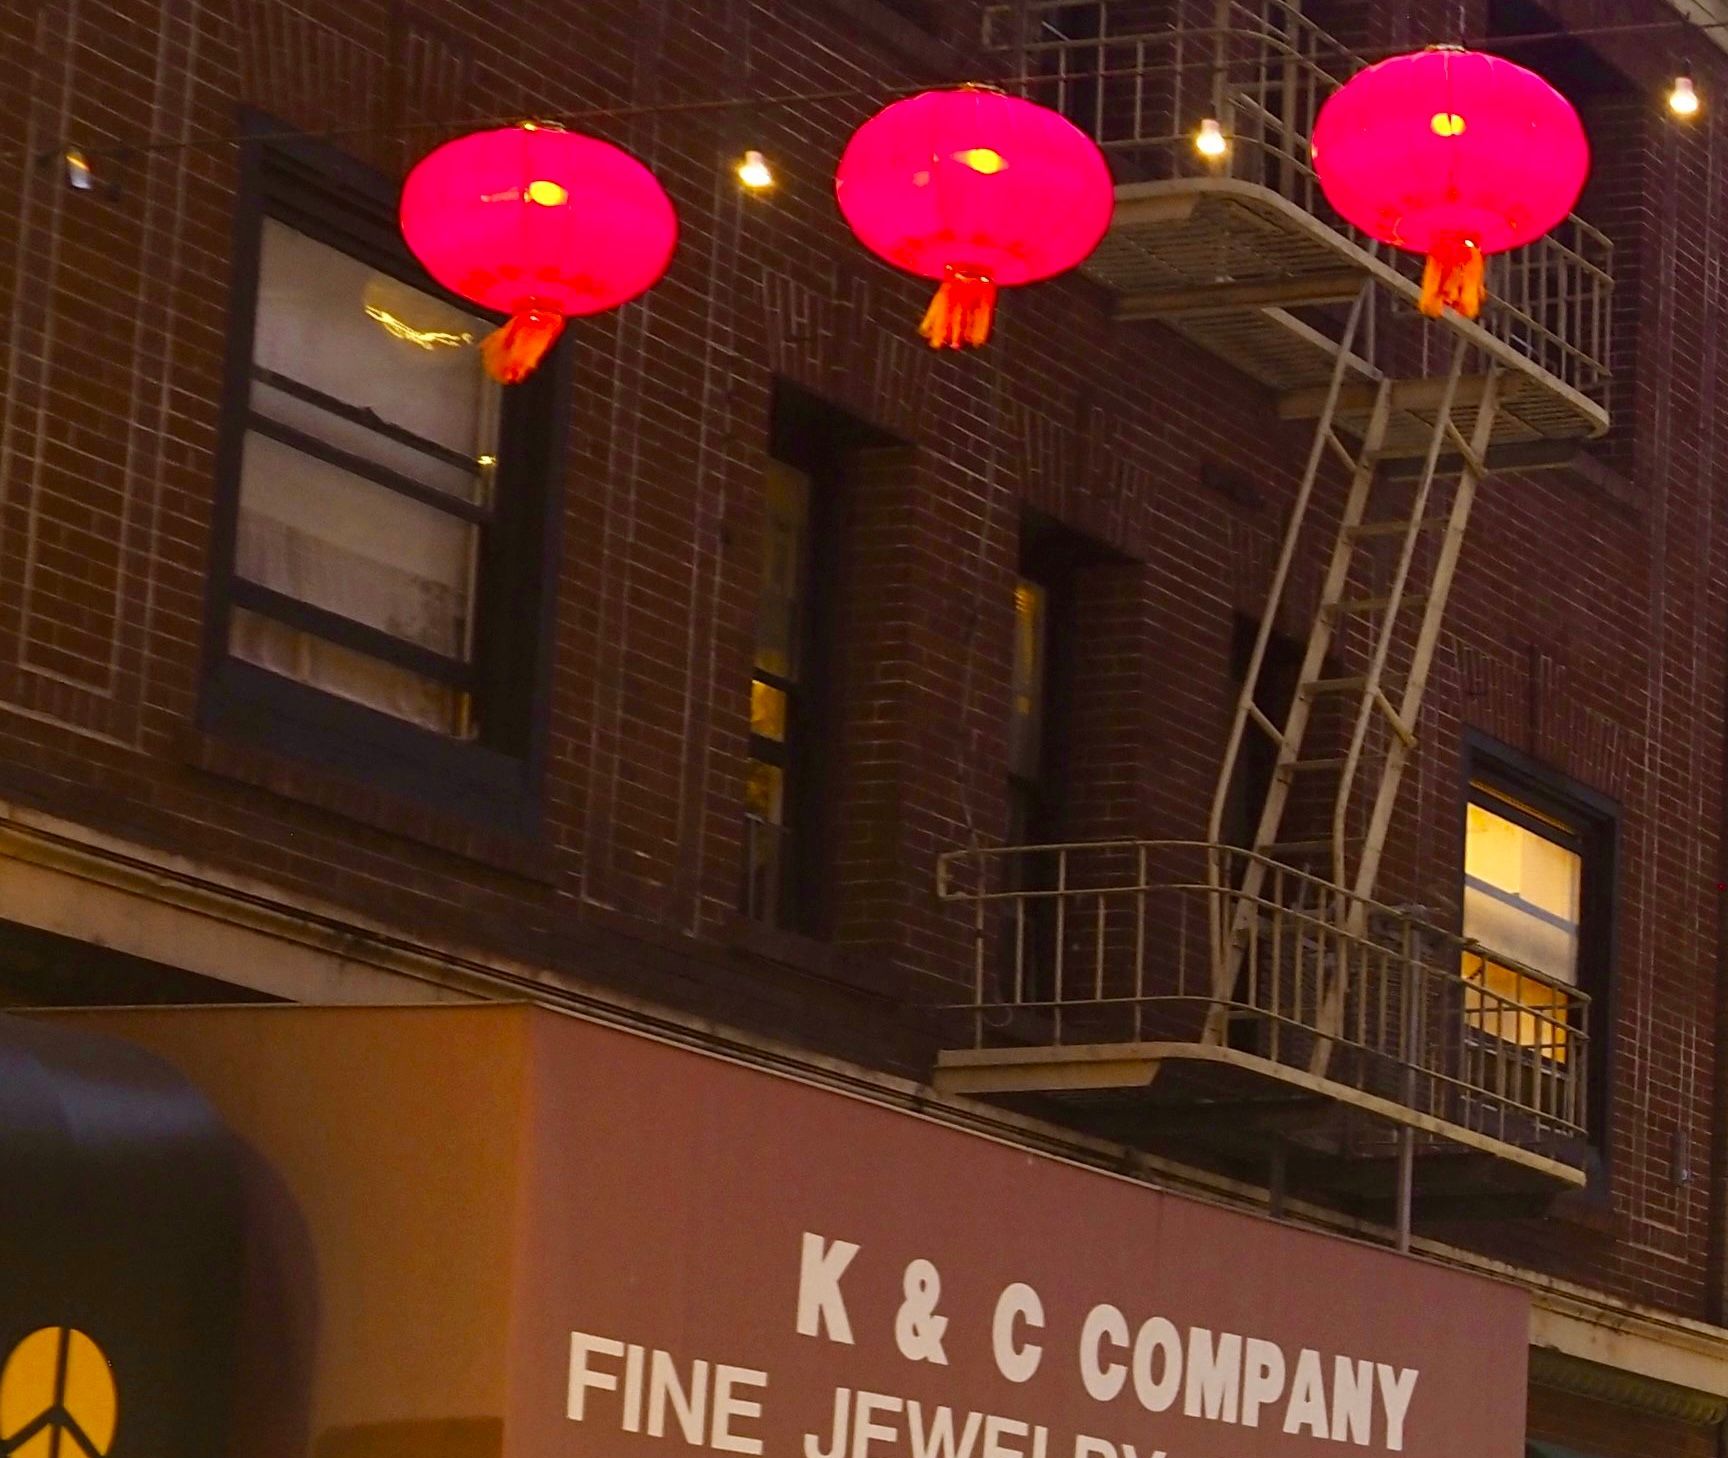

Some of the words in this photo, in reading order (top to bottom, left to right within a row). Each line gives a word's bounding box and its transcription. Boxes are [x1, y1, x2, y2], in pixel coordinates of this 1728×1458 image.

[565, 1330, 769, 1457] FINE
[795, 1231, 862, 1346] K
[893, 1257, 950, 1367] &
[992, 1282, 1045, 1384] C
[1078, 1302, 1421, 1453] COMPANY
